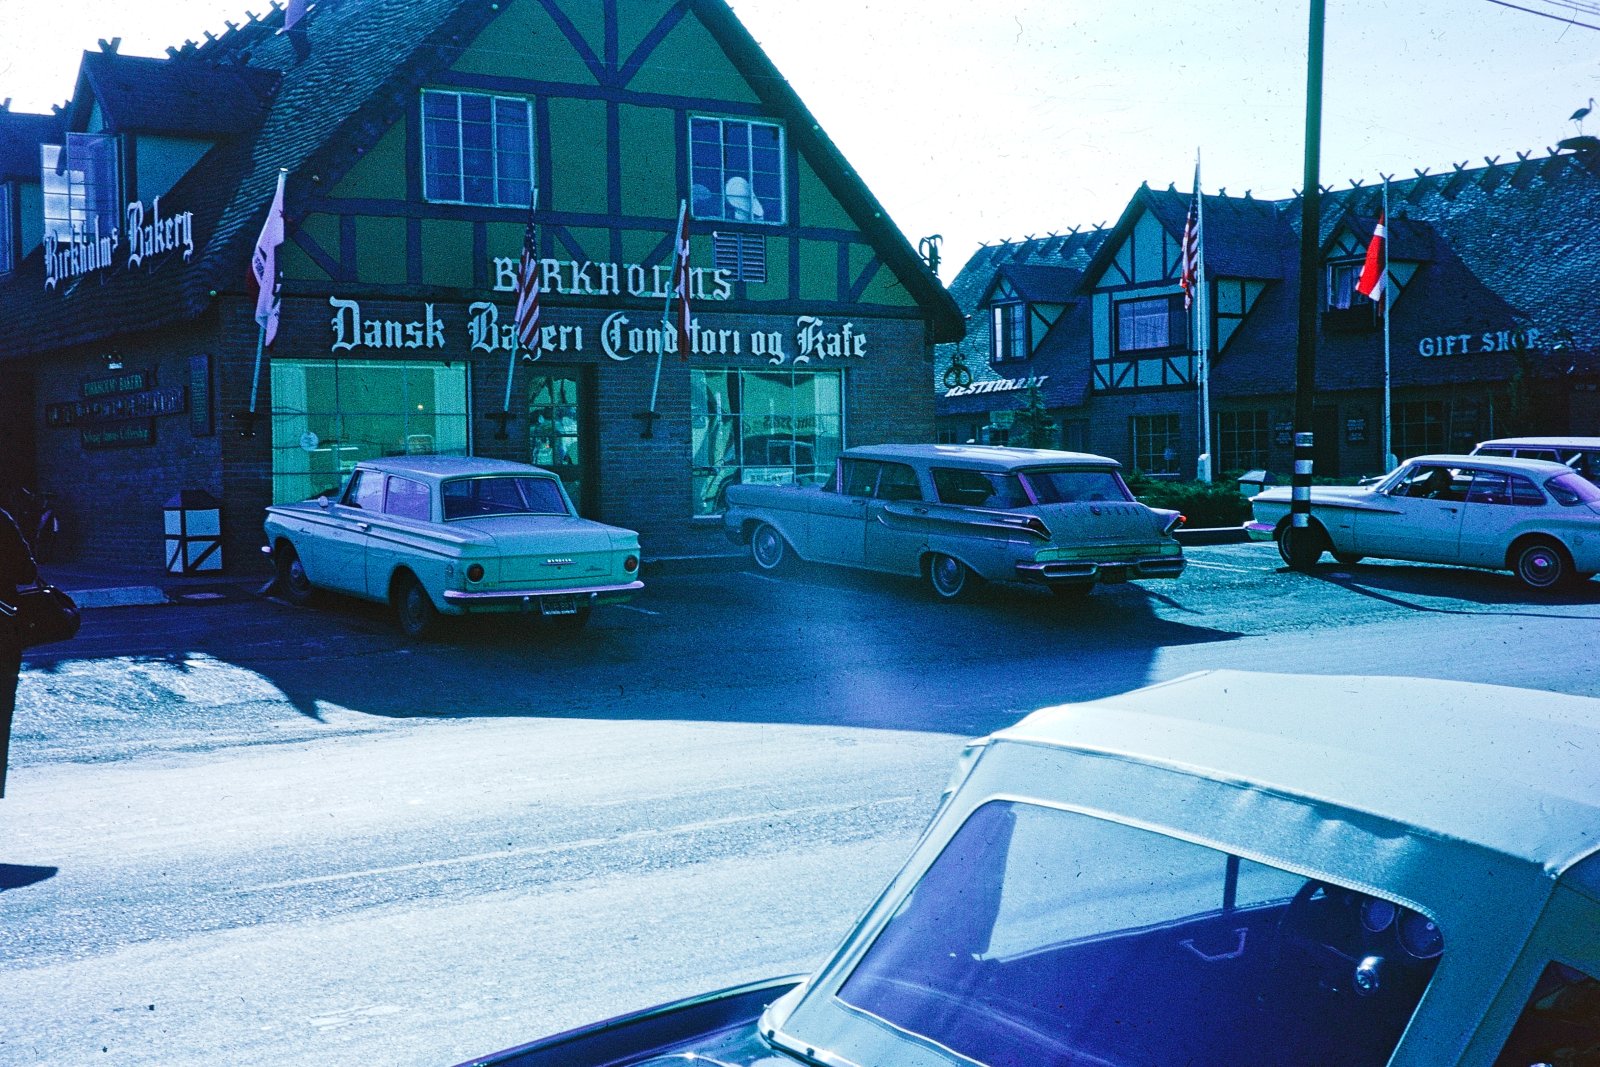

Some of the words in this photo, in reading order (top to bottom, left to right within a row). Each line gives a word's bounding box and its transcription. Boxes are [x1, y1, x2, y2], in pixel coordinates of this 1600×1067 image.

[127, 195, 194, 271] Bakery
[493, 256, 732, 300] BRKHOLMS
[329, 295, 446, 352] Dansk
[467, 301, 583, 361] Baeri
[601, 311, 741, 361] Condtori
[746, 331, 785, 365] og
[793, 315, 867, 365] Kafe
[1419, 334, 1472, 357] GIFT
